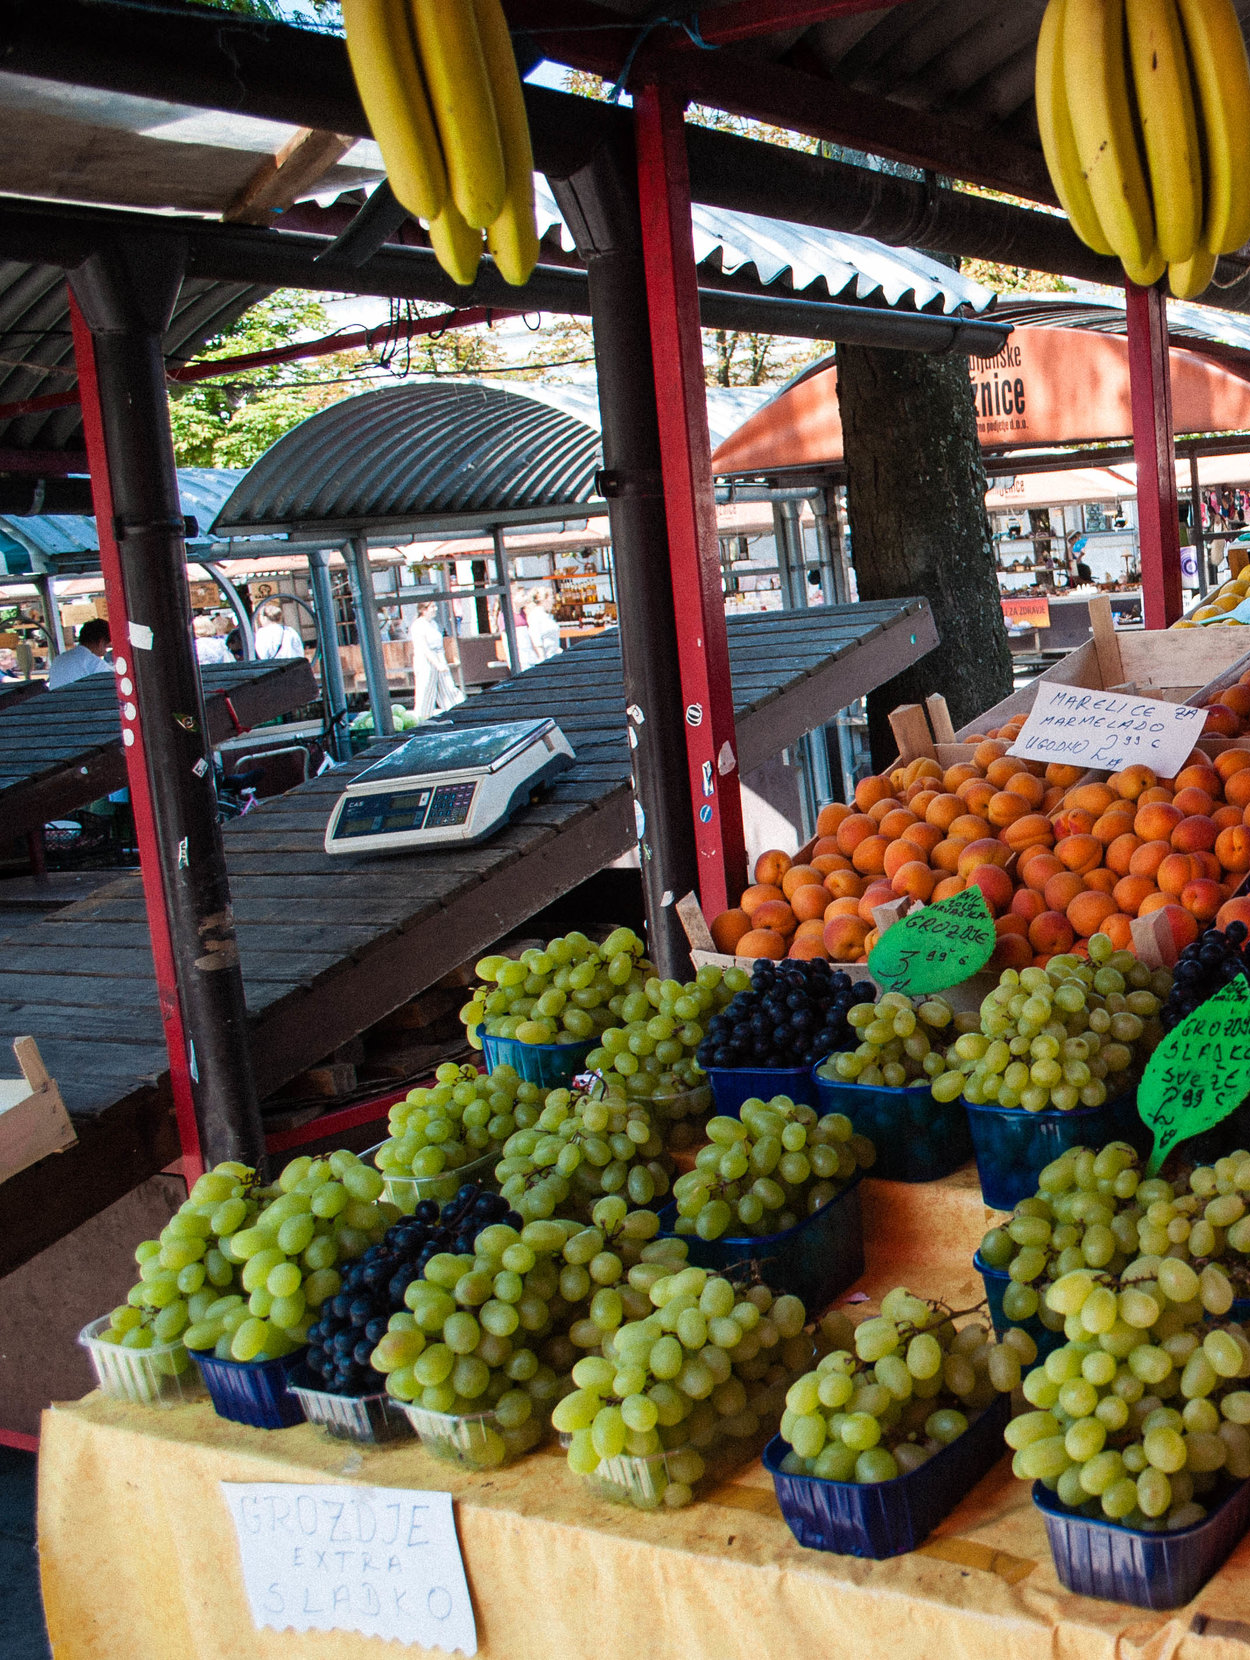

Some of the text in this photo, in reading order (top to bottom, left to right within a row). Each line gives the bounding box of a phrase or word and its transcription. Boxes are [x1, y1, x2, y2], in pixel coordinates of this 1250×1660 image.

[1050, 691, 1199, 720] MARELICE ZA
[1039, 714, 1166, 733] MARMELADO
[1025, 735, 1090, 754] UGODNO
[348, 800, 365, 809] CAS
[904, 915, 990, 945] GROZDJE
[240, 1494, 431, 1548] GROZDJE
[293, 1546, 403, 1574] EXTRA
[263, 1581, 454, 1622] SLADKO
